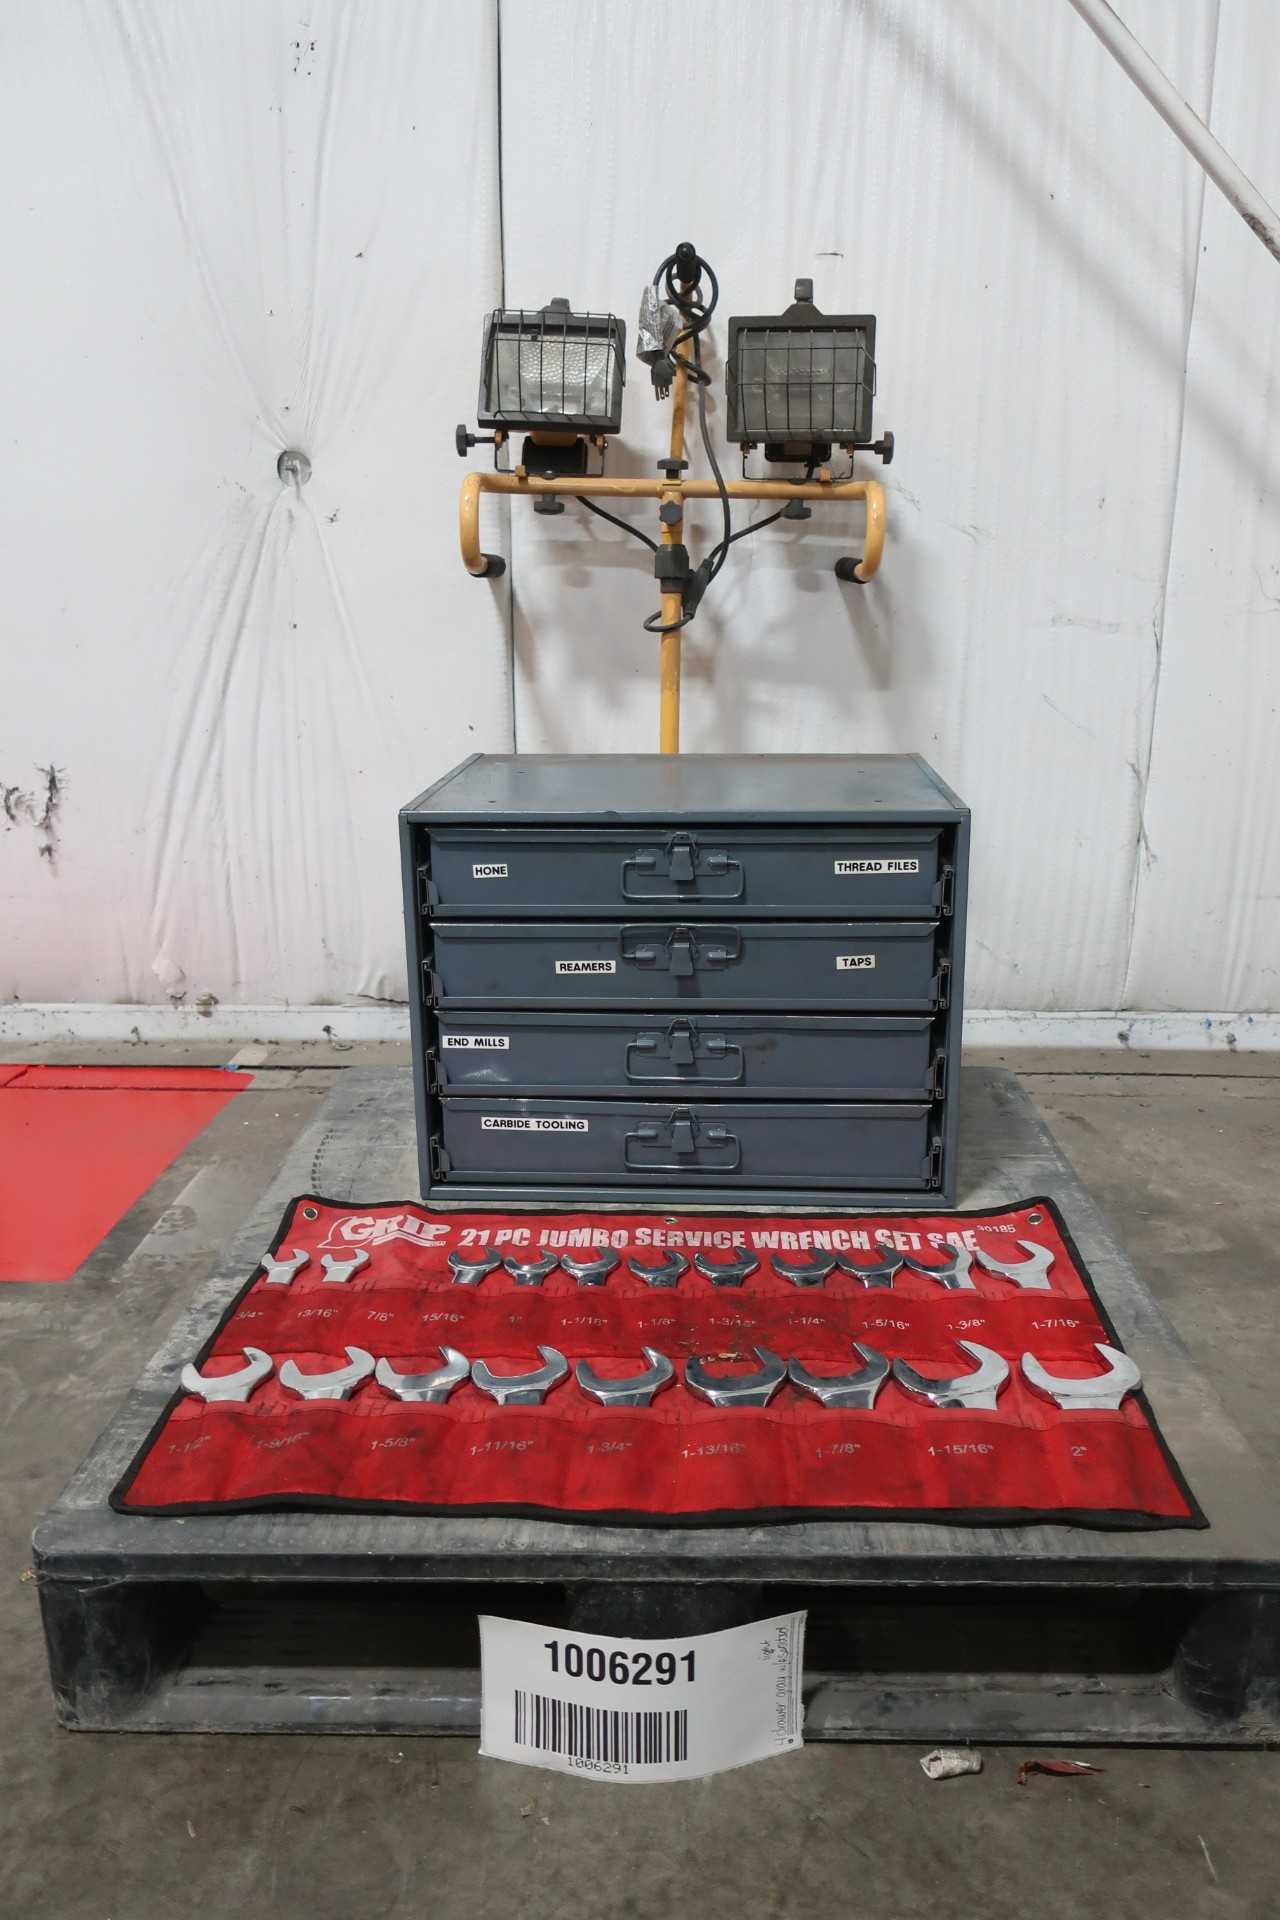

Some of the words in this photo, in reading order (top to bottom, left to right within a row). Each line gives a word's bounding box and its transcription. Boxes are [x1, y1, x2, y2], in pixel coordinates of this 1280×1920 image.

[474, 864, 507, 877] HONE
[837, 861, 883, 873] THREAD
[888, 860, 917, 872] FILES
[559, 961, 612, 973] REAMERS
[843, 956, 872, 968] TAPS
[447, 1037, 470, 1048] END
[474, 1037, 505, 1048] MILLS
[484, 1118, 531, 1130] CARBIDE
[536, 1119, 585, 1131] TOOLING
[339, 1214, 452, 1242] GRIP
[460, 1228, 488, 1247] 21
[496, 1230, 530, 1247] PC
[537, 1227, 628, 1249] JUMBO
[635, 1228, 746, 1249] SERVICE
[751, 1229, 870, 1250] WRENCH
[874, 1229, 921, 1251] SET
[927, 1230, 979, 1252] SAE
[544, 1640, 696, 1686] 1006291
[567, 1756, 630, 1775] 1006291
